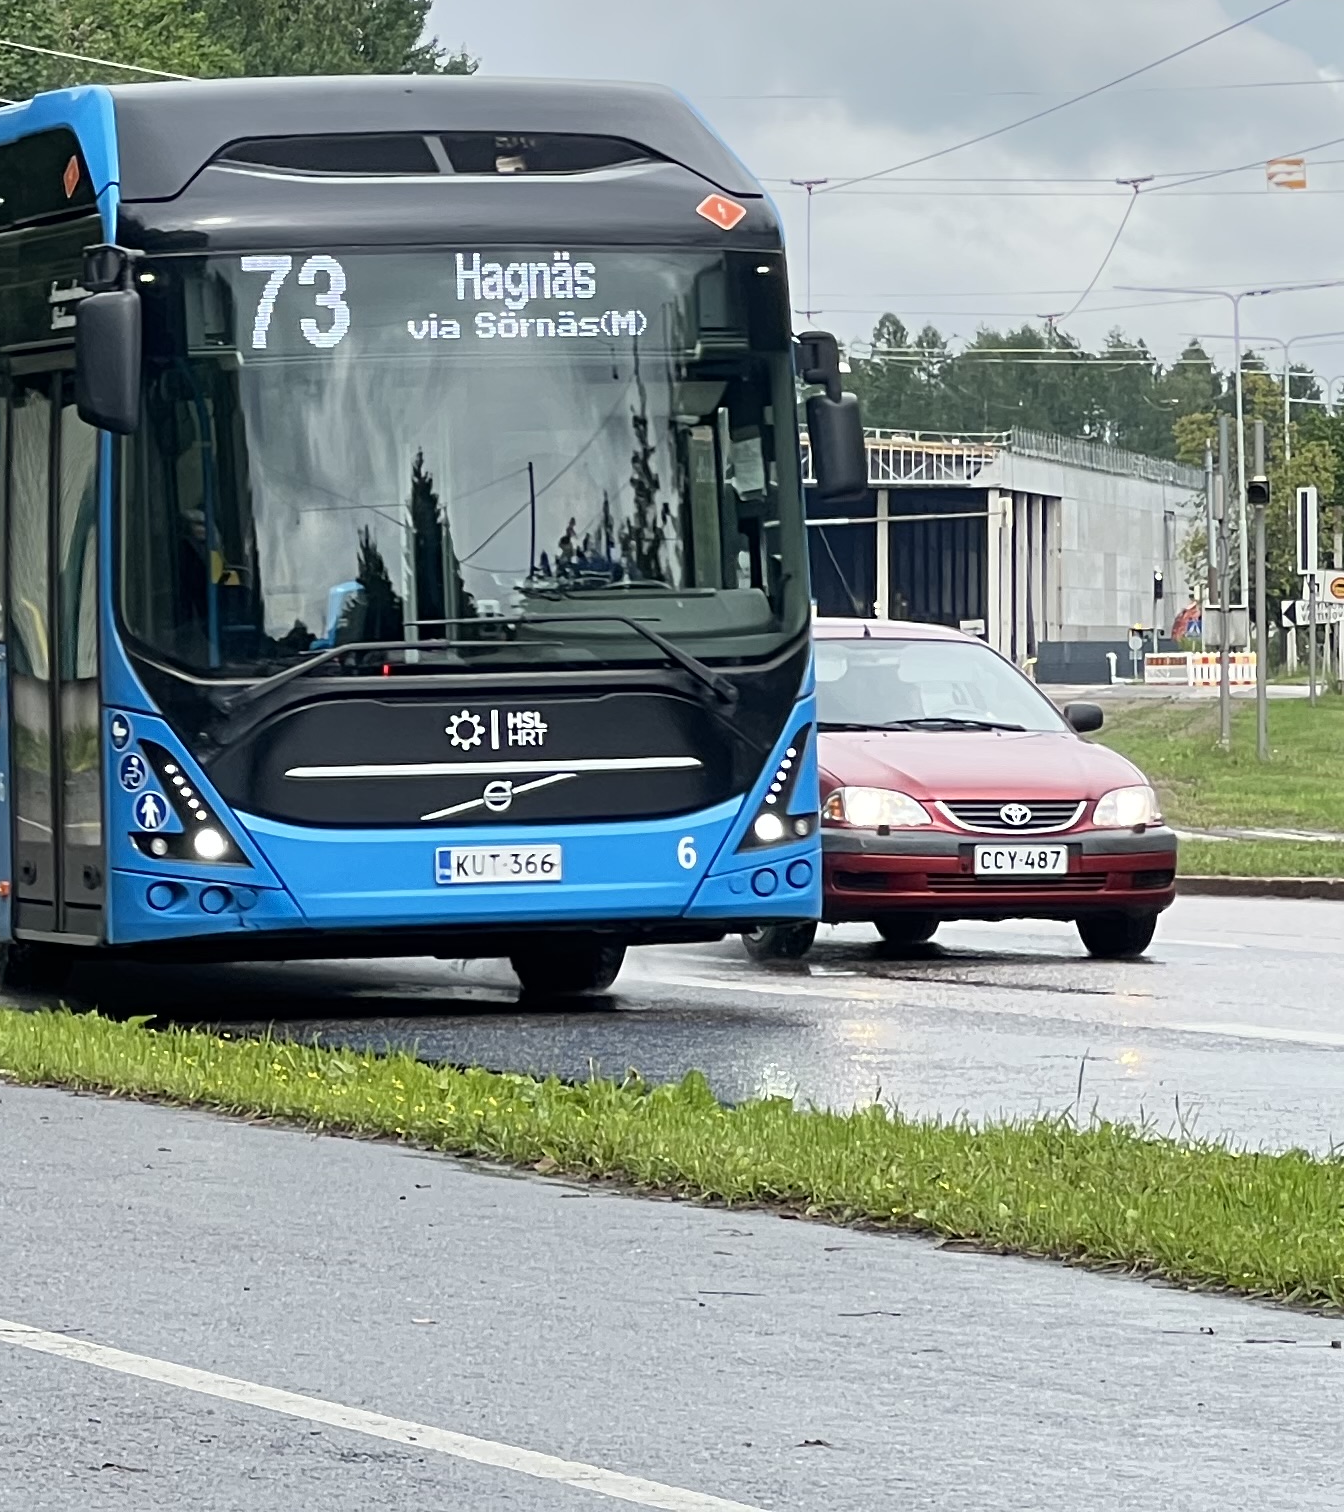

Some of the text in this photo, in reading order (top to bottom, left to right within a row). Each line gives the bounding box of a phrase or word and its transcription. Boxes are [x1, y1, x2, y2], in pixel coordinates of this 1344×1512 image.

[455, 251, 597, 311] Hagnäs
[241, 254, 350, 349] 73
[407, 310, 648, 340] via Sörnäs(M)
[507, 711, 548, 729] HSL
[507, 729, 548, 746] HRT
[456, 852, 555, 877] KUT-366
[676, 836, 697, 870] 6
[980, 850, 1062, 870] CCY-487
